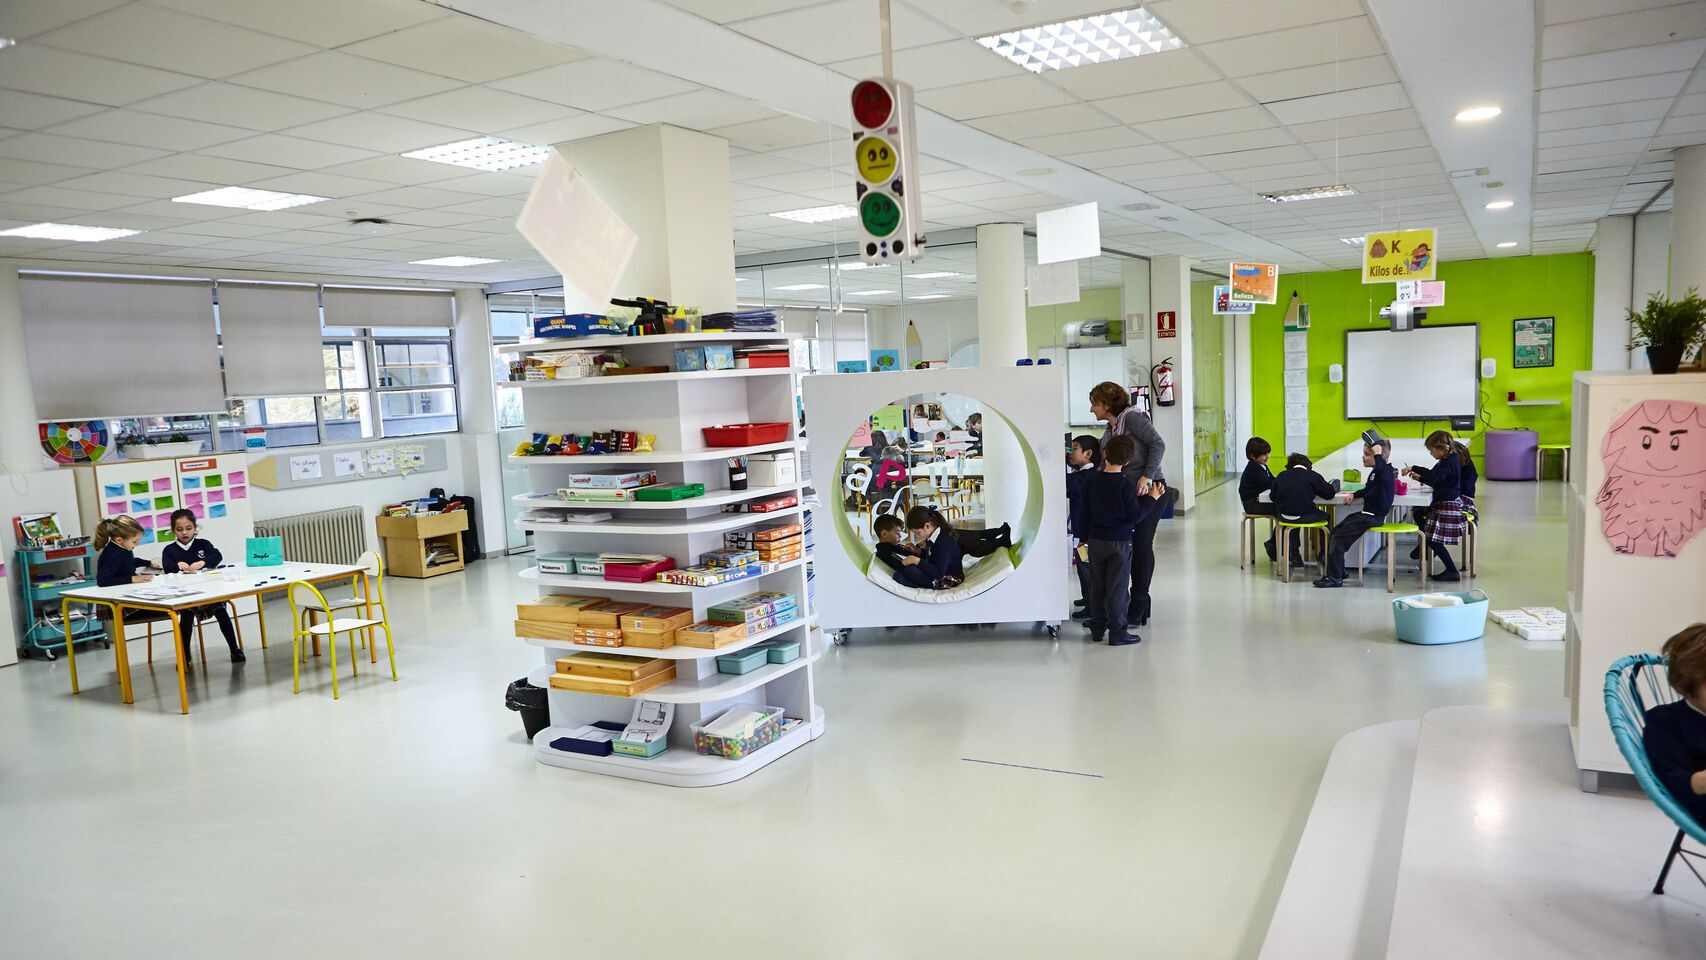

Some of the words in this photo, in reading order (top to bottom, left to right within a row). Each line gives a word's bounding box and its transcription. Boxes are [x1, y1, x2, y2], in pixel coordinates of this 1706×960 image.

[1391, 240, 1402, 254] K
[1267, 265, 1275, 277] B
[1369, 265, 1390, 277] Kilos
[1392, 263, 1412, 276] de...
[1217, 287, 1224, 296] T
